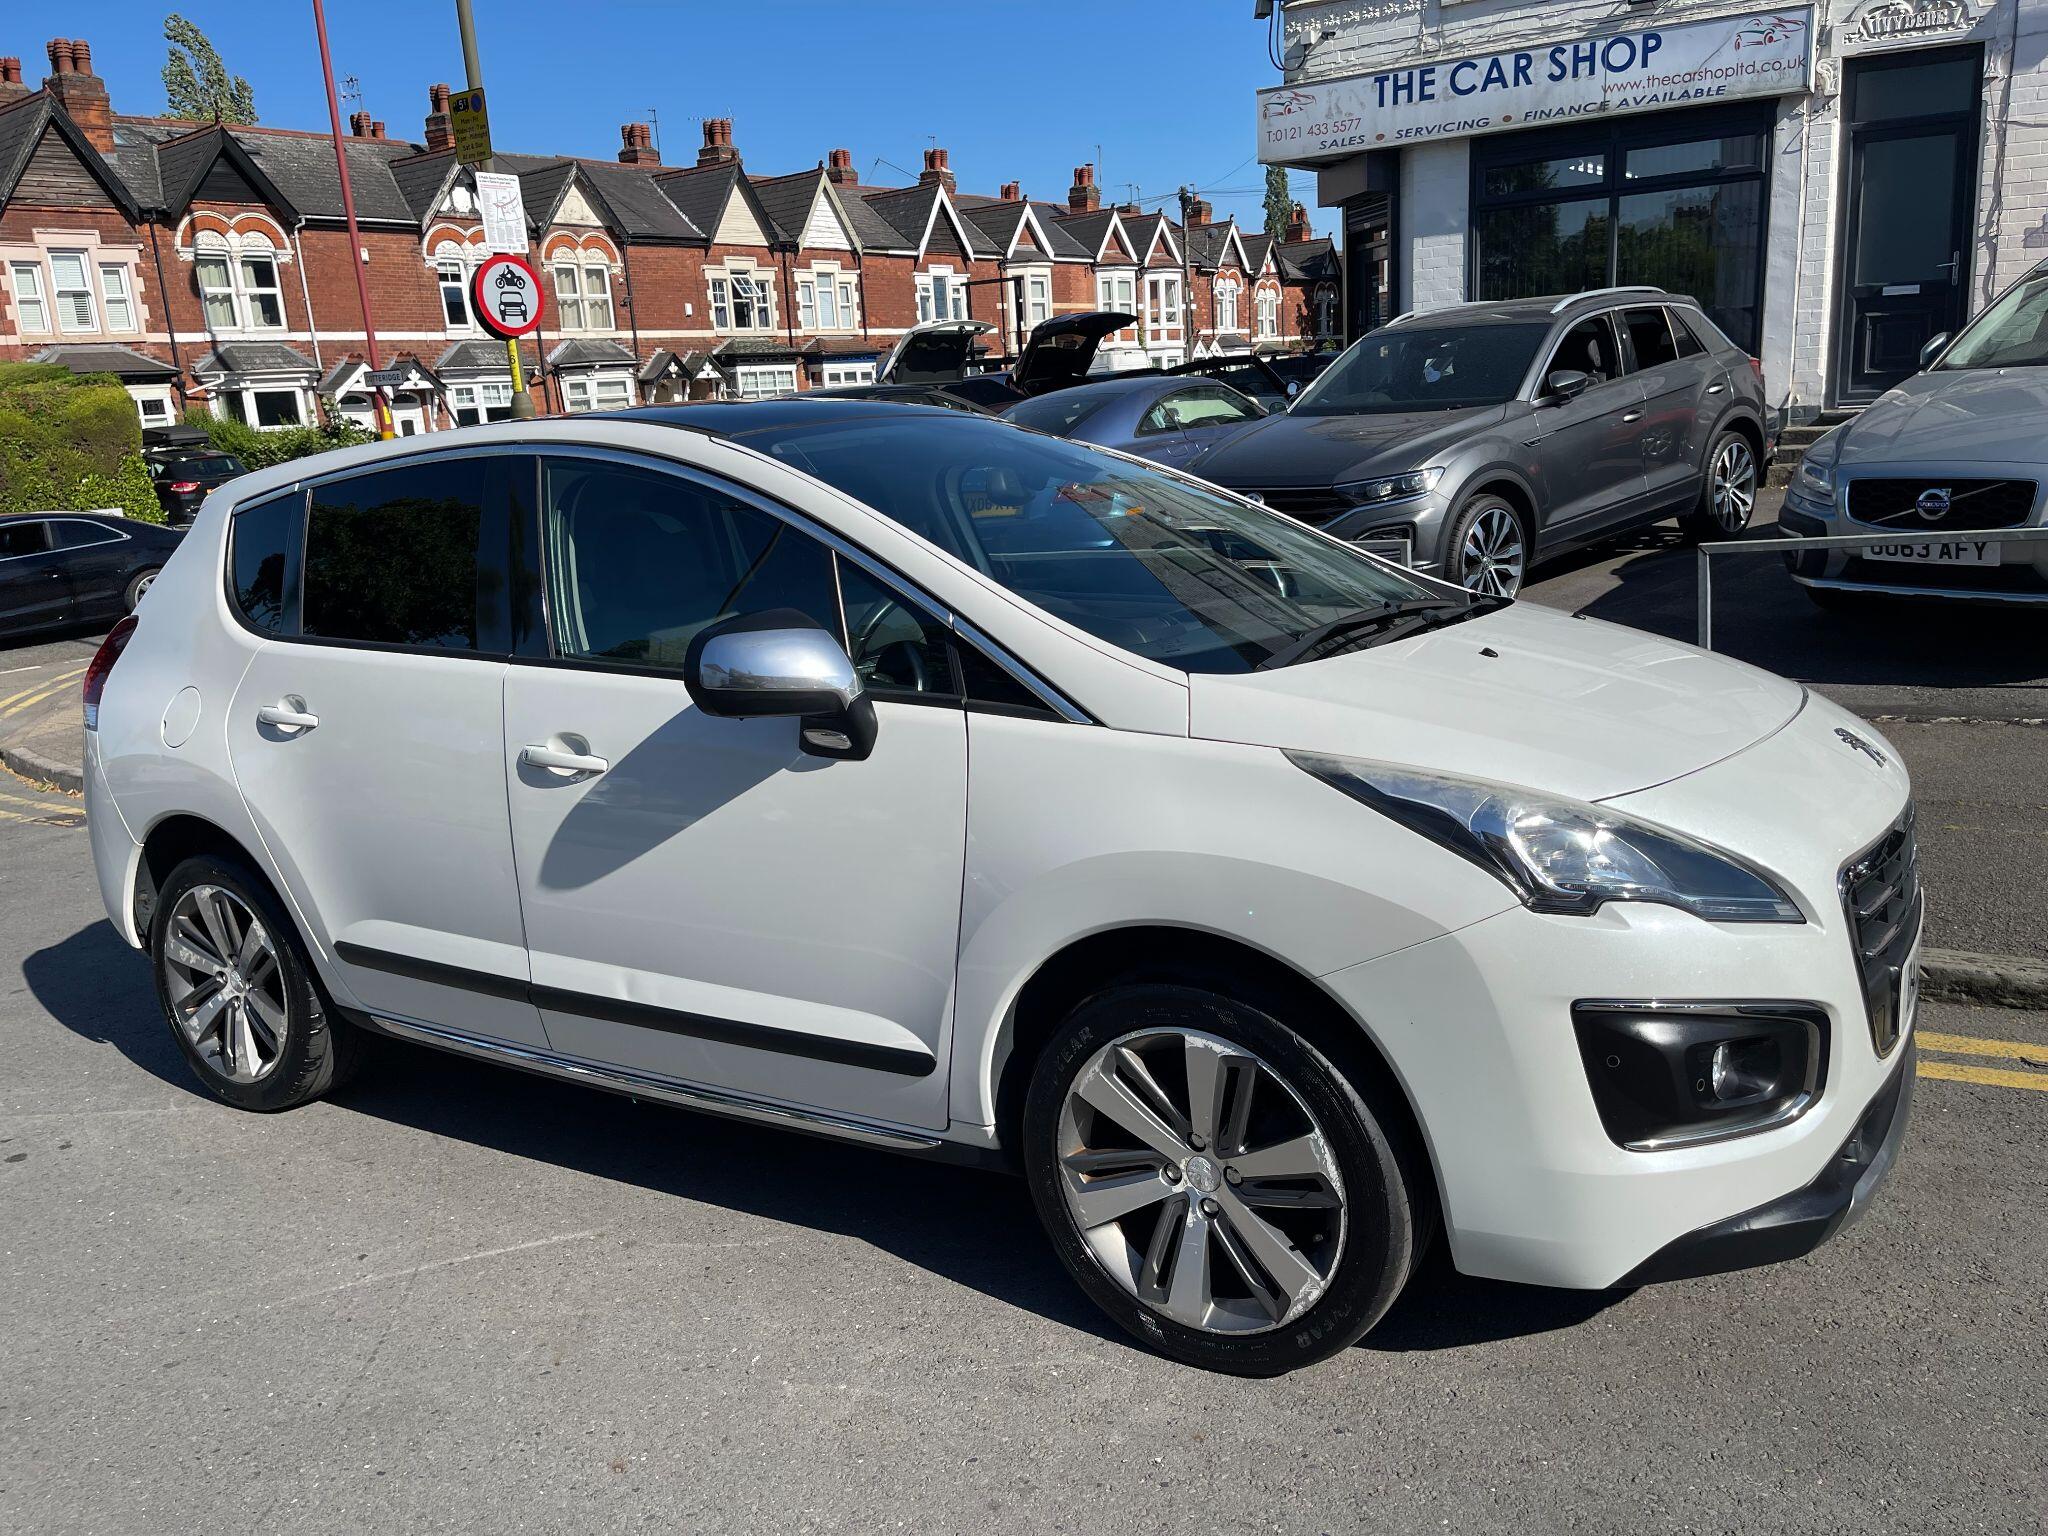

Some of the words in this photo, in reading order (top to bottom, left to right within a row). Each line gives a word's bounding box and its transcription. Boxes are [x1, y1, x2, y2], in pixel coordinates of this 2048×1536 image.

[1374, 67, 1436, 107] THE
[1450, 53, 1533, 95] CAR
[1548, 33, 1662, 82] SHOP
[1602, 55, 1806, 95] www.thecarshopltd.co.uk
[1267, 126, 1302, 143] T:0121
[1307, 122, 1329, 137] 433
[1332, 118, 1362, 134] 5577
[1319, 135, 1365, 149] SALES
[1395, 117, 1490, 139] SERVICING
[1523, 101, 1610, 121] FINANCE
[1616, 85, 1727, 108] AVAILABLE
[1939, 542, 1987, 560] AFY
